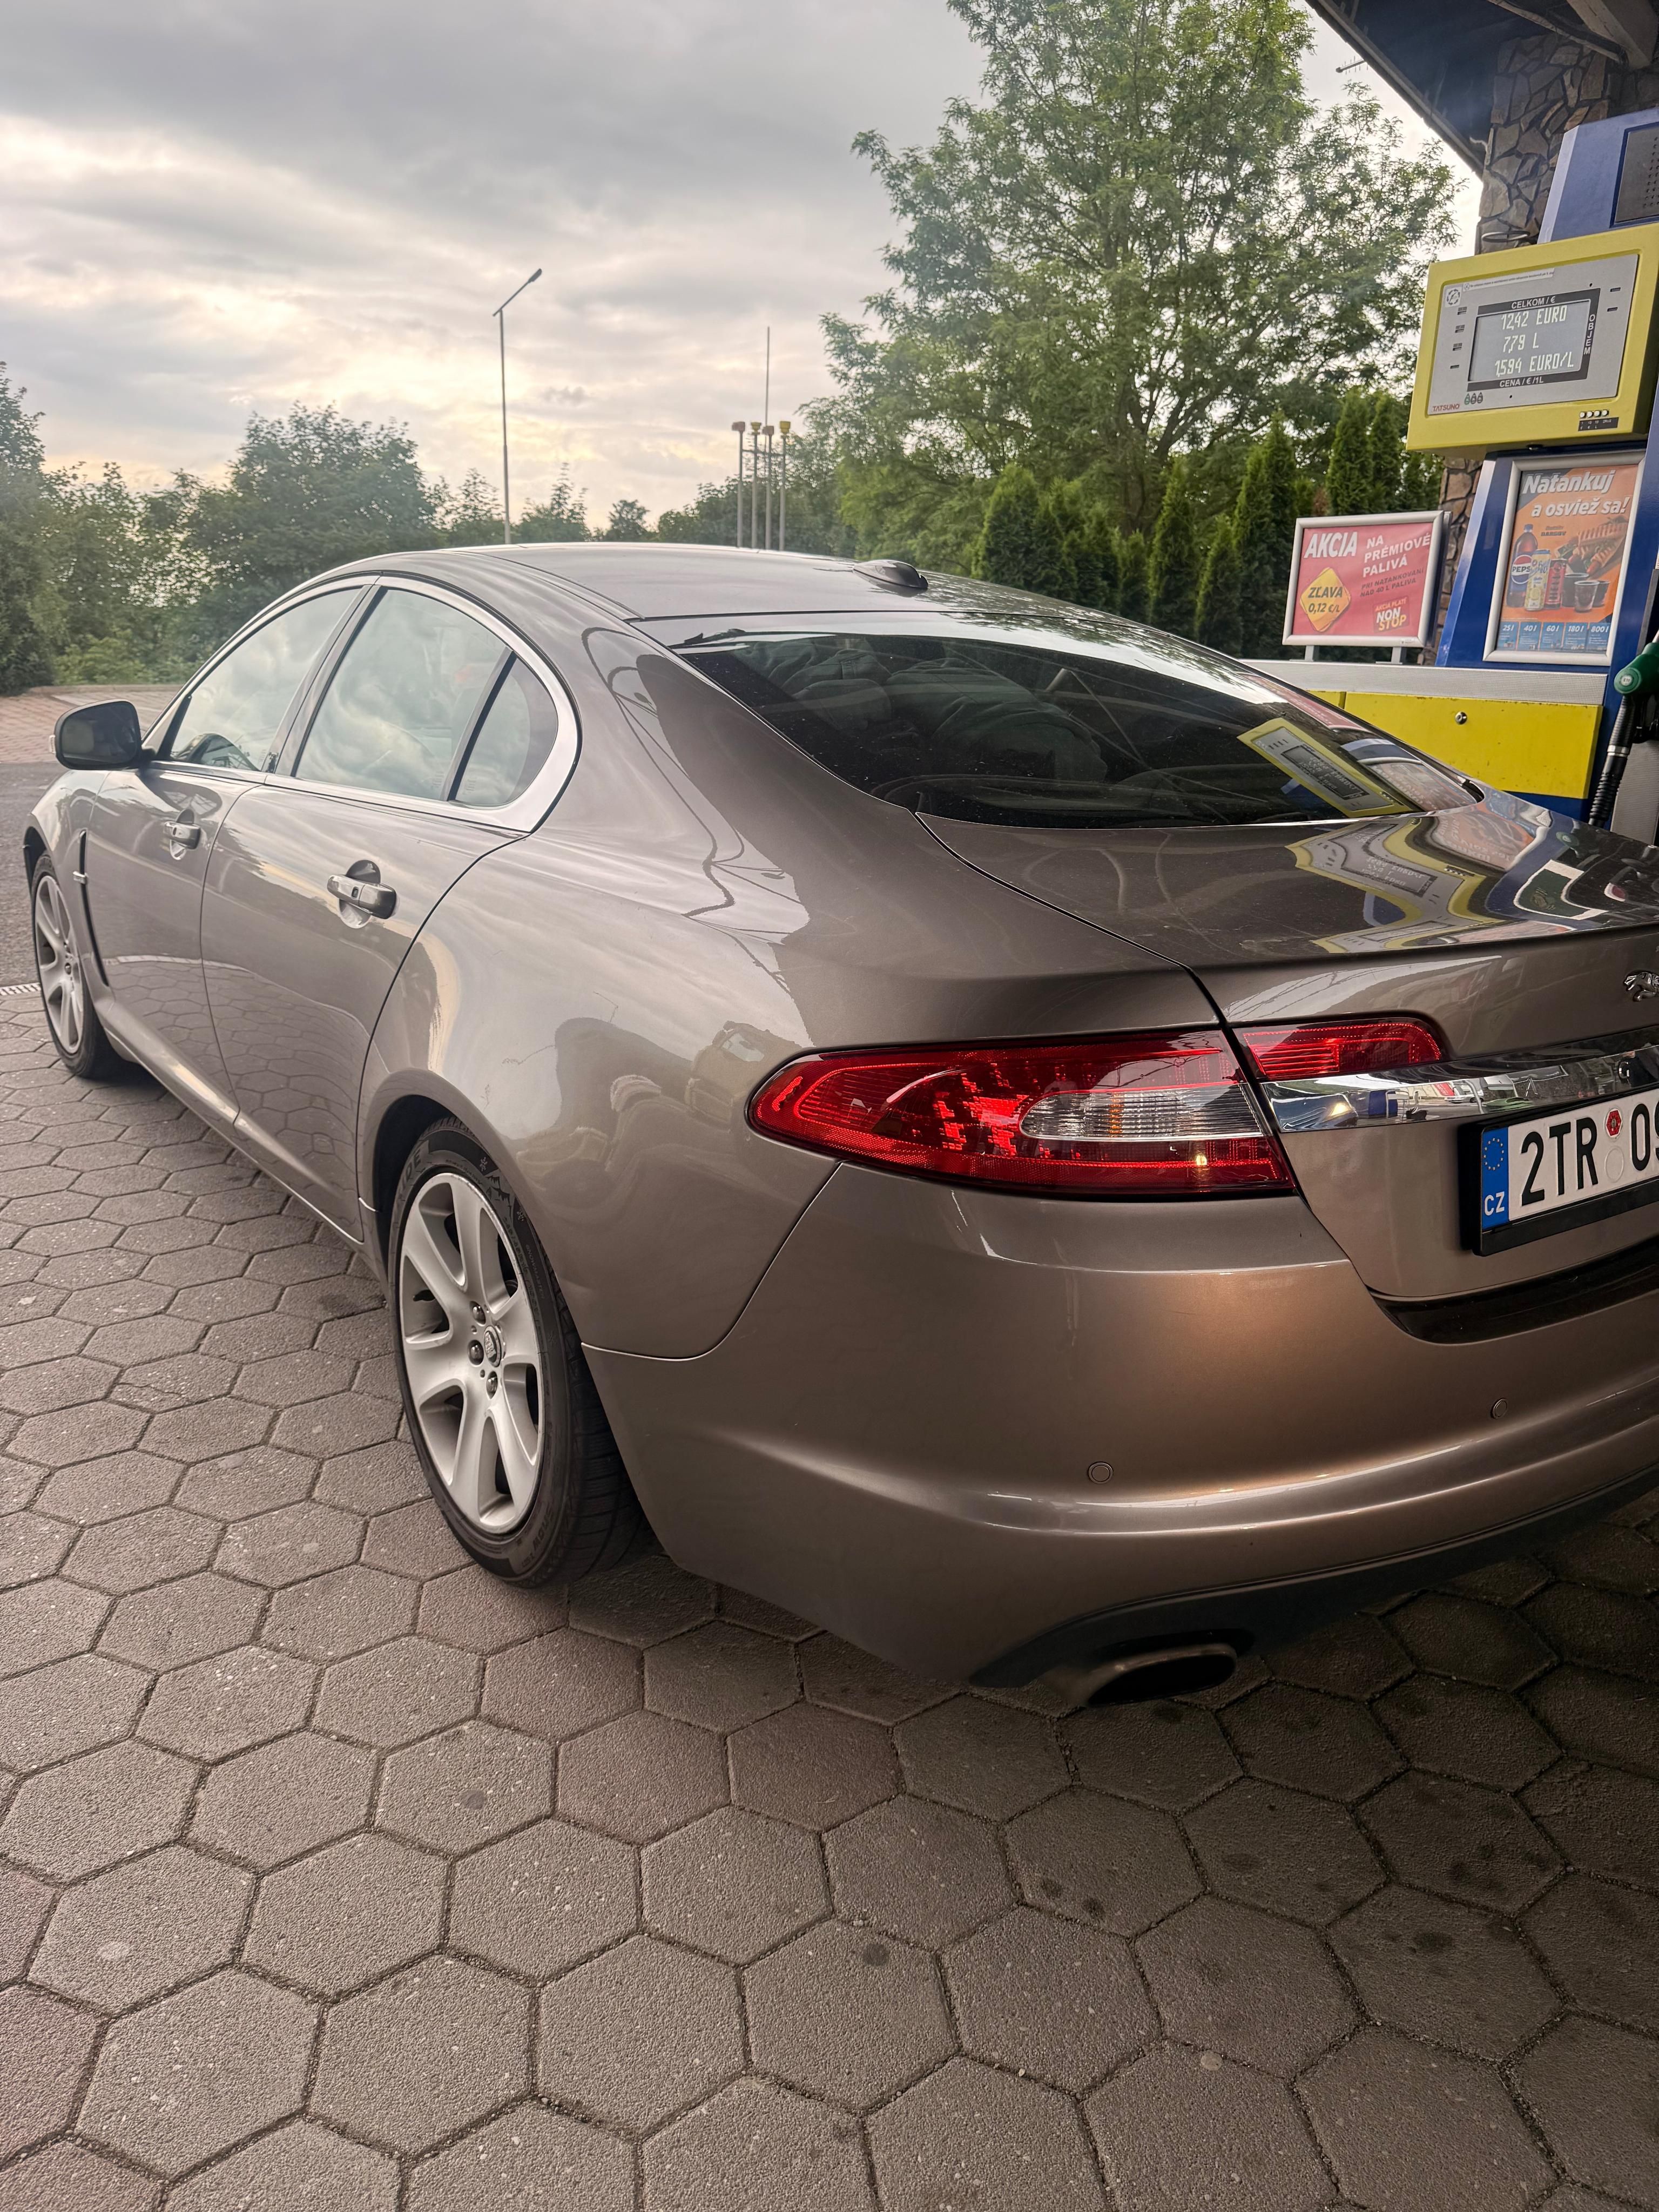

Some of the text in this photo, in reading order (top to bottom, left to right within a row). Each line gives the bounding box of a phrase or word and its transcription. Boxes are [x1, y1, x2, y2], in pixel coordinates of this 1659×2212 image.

[1512, 298, 1545, 309] CELKOM
[1536, 305, 1567, 325] EURO
[1533, 332, 1539, 348] L
[1583, 314, 1595, 354] OBJEM
[1529, 352, 1574, 372] EURO/L
[1499, 379, 1520, 387] CENA
[1433, 403, 1460, 412] TATSUNO
[1522, 470, 1616, 494] Natankuj
[1531, 496, 1630, 517] a osviež sa!
[1304, 531, 1358, 558] AKCIA
[1364, 532, 1431, 563] PRÉMIOVÉ
[1366, 535, 1384, 549] NA
[1363, 554, 1407, 578] PALIVÁ
[1307, 586, 1343, 598] ZĽAVA
[1308, 603, 1340, 614] 0,12 €/L
[1375, 603, 1391, 612] AKCIA
[1376, 606, 1401, 623] NON
[1378, 614, 1407, 631] STOP
[1521, 1099, 1659, 1206] 2TR 0
[1485, 1191, 1505, 1215] CZ
